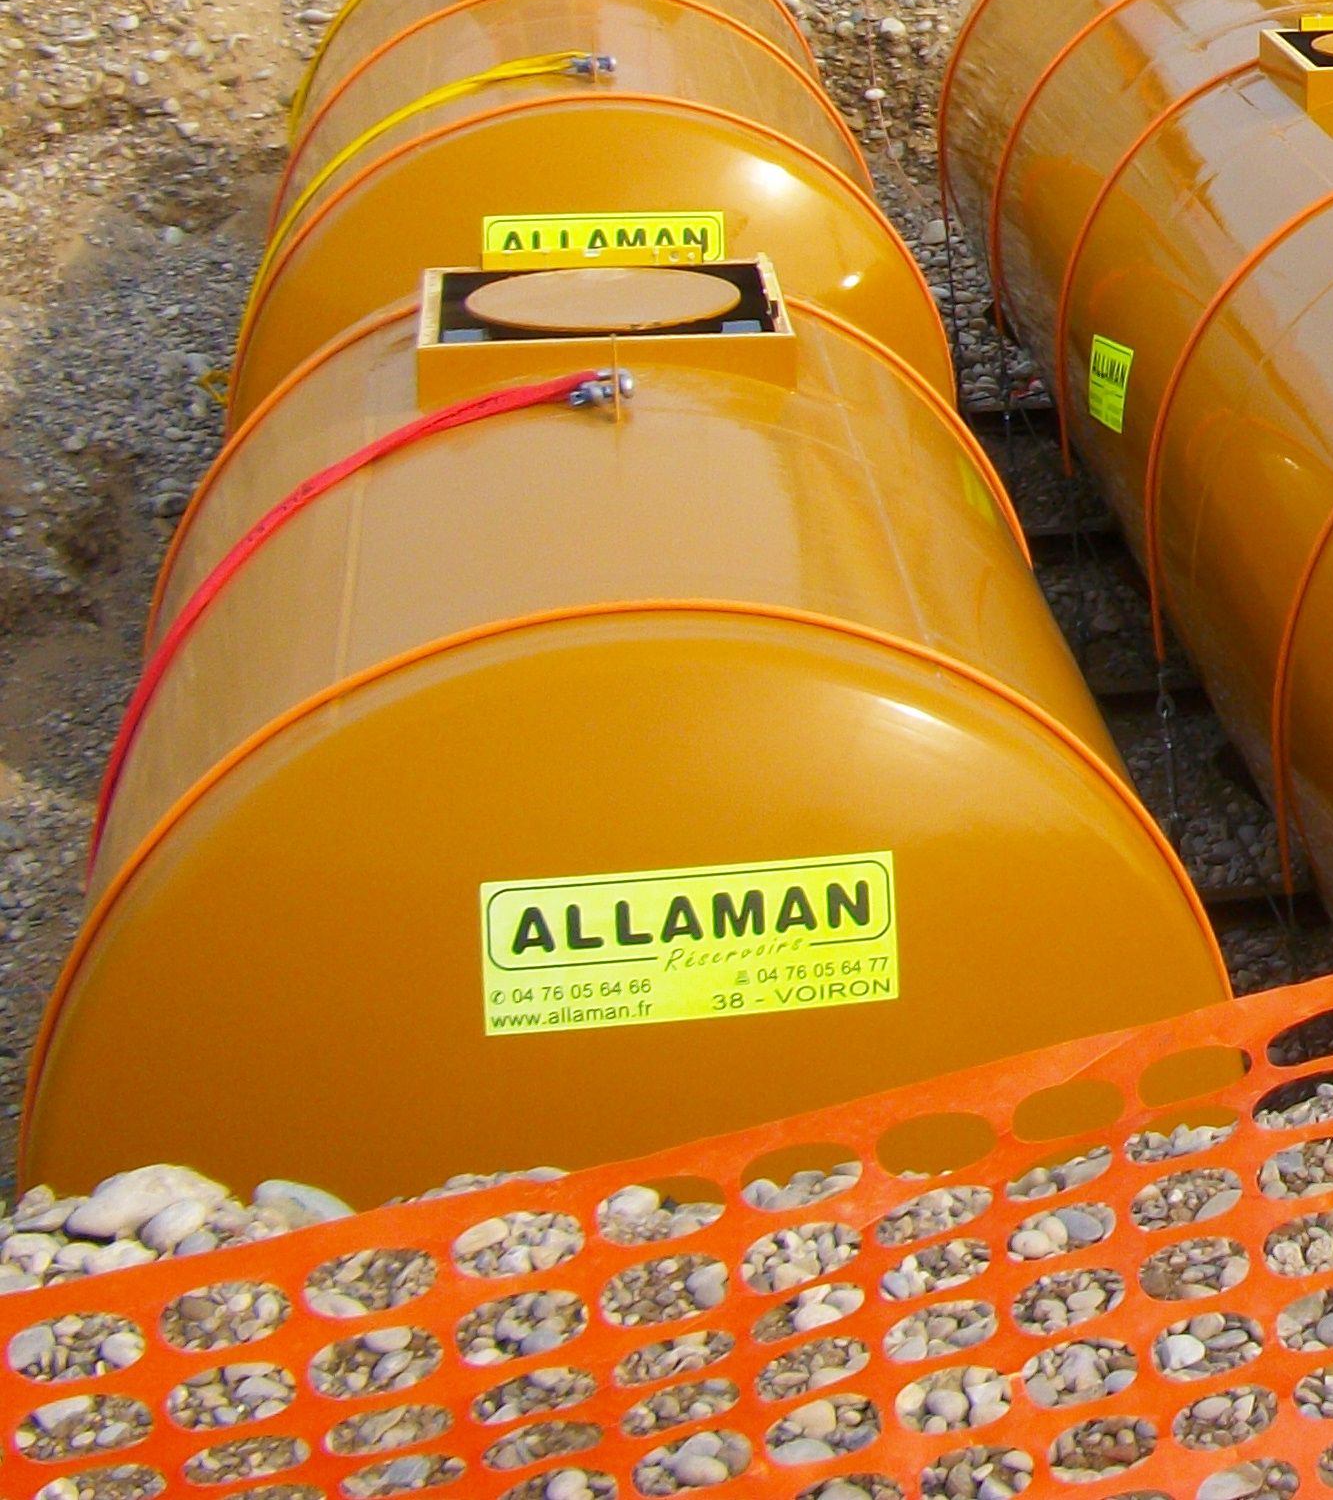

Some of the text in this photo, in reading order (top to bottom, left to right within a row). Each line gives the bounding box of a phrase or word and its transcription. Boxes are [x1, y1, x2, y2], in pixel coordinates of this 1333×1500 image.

[511, 879, 870, 956] ALLAMAN
[756, 956, 890, 984] 04 76 05 64 77
[512, 978, 652, 1005] 04 76 05 64 66
[711, 993, 746, 1011] 38
[775, 977, 891, 1005] VOIRON
[490, 1000, 653, 1029] www.allaman.fr
